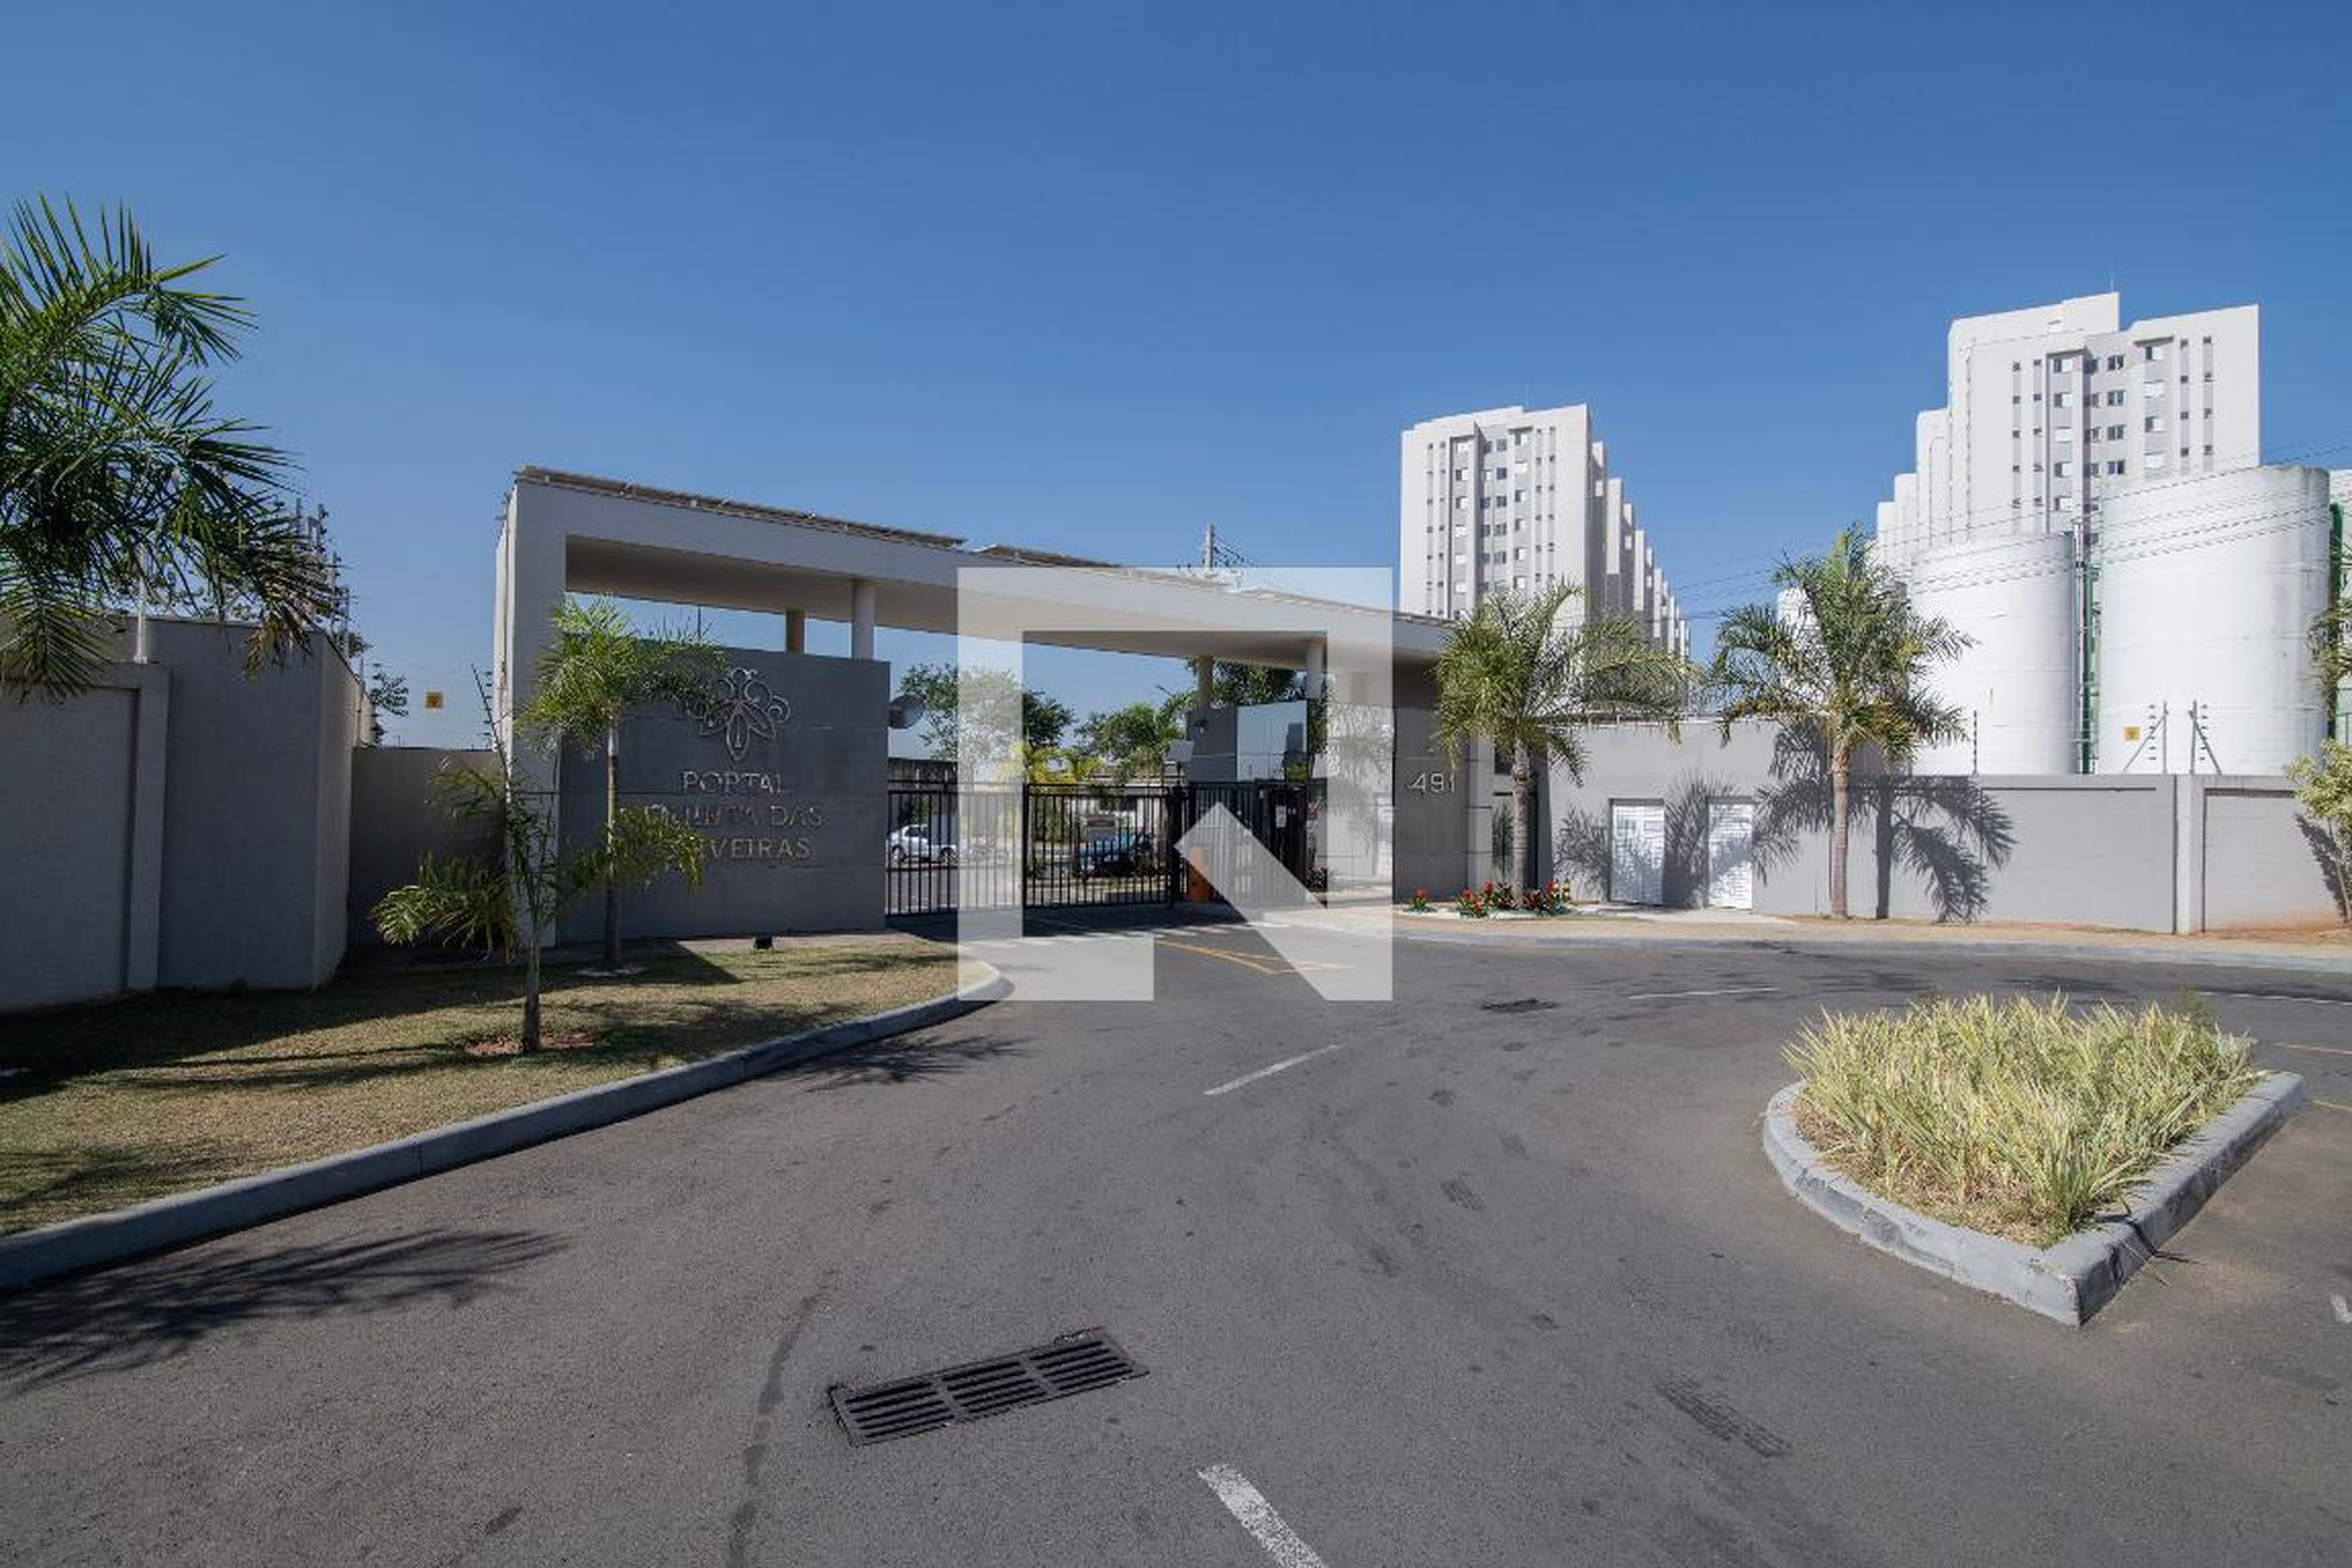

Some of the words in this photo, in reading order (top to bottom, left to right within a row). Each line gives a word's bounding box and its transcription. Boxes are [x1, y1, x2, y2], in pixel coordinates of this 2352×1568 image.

[682, 771, 785, 794] PORTAL
[1408, 773, 1455, 793] 491
[771, 804, 822, 826] DAS
